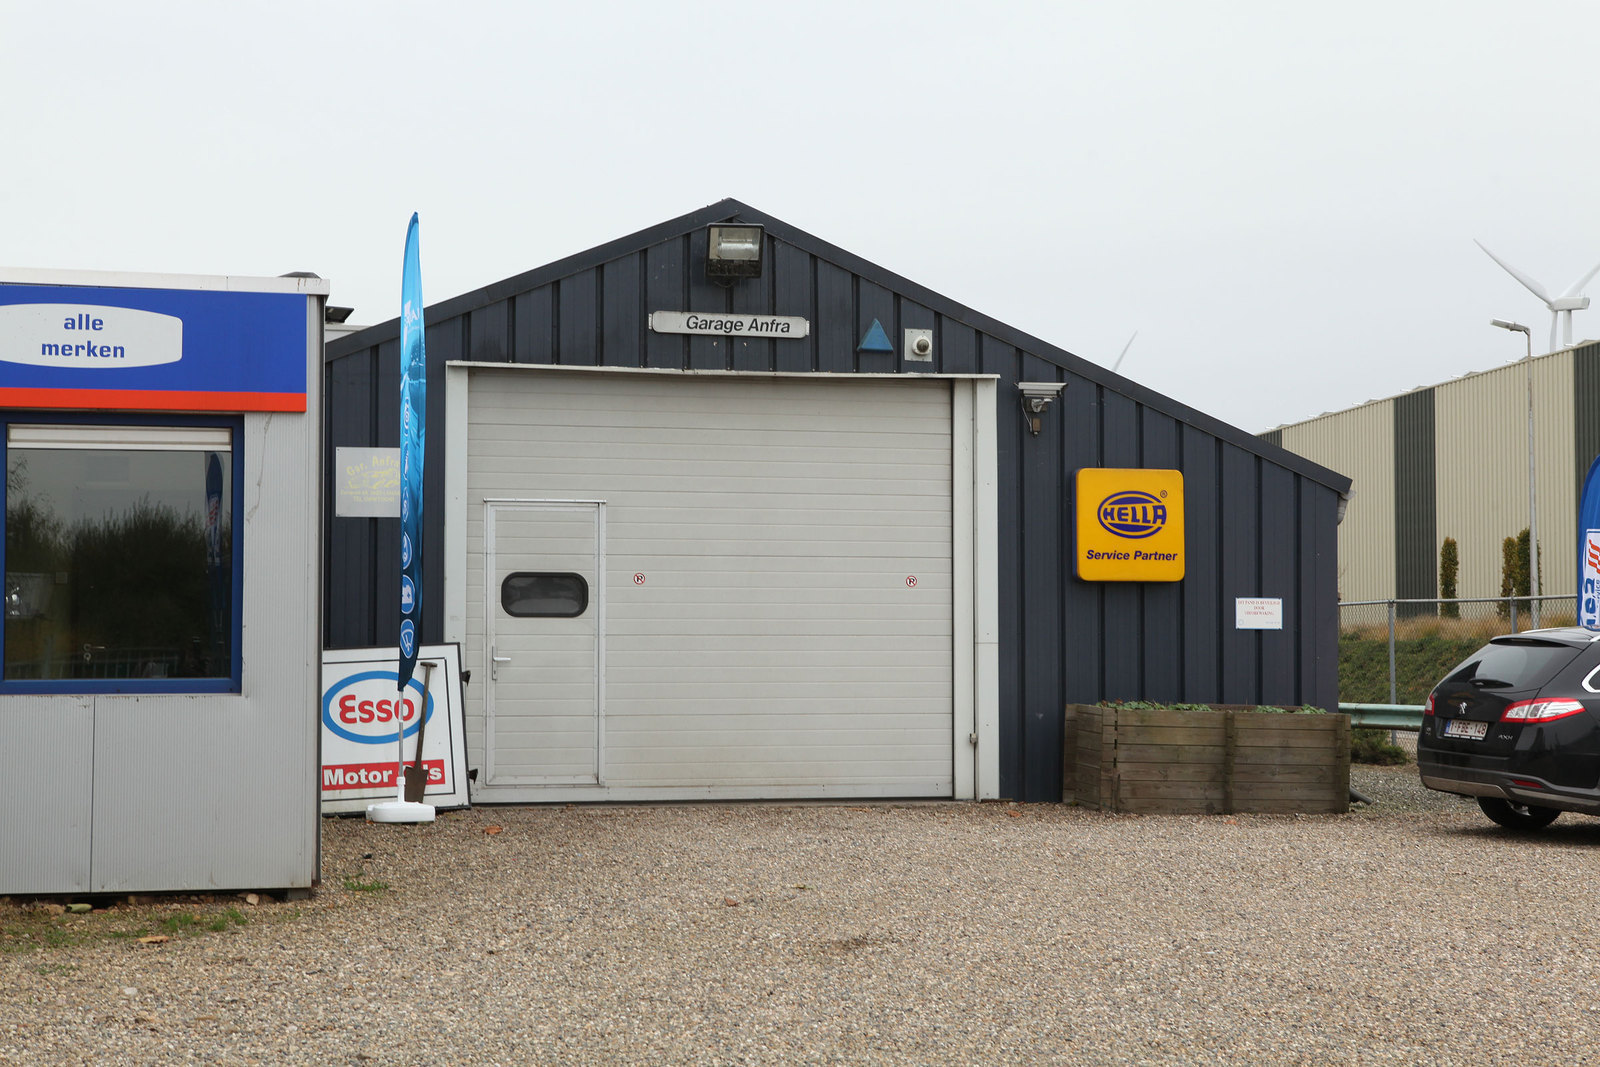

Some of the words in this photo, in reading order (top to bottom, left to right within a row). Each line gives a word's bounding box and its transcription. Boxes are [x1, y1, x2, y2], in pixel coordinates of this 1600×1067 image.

[63, 313, 104, 331] alle
[686, 315, 744, 334] Garage
[747, 318, 791, 333] Anfra
[41, 340, 125, 358] merken
[1102, 504, 1167, 525] HELLA
[1086, 549, 1130, 560] Service
[1133, 550, 1178, 561] Partner
[339, 694, 414, 724] Esso
[323, 767, 393, 786] Motor
